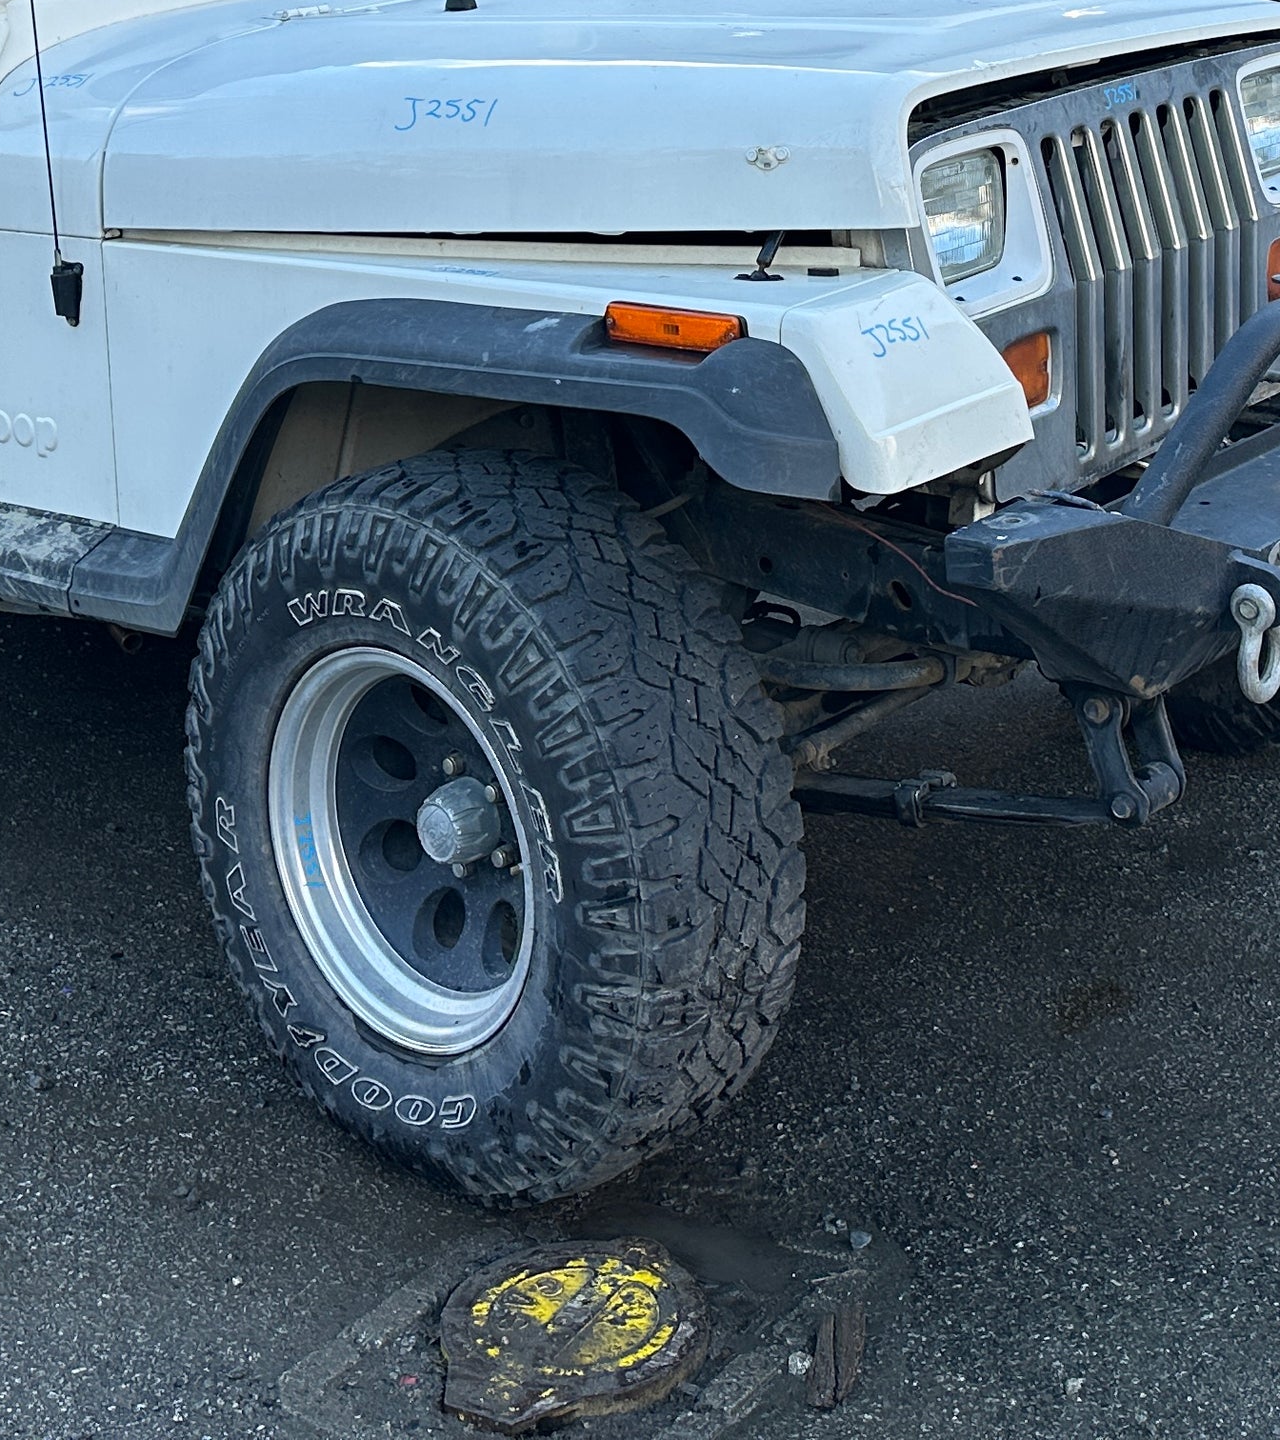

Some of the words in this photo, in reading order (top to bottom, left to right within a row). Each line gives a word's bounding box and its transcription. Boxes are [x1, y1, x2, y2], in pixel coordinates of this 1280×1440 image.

[394, 97, 499, 131] J2551
[861, 315, 930, 358] J2551
[286, 587, 565, 905] WRANGLER
[214, 796, 478, 1130] GOODYEAR
